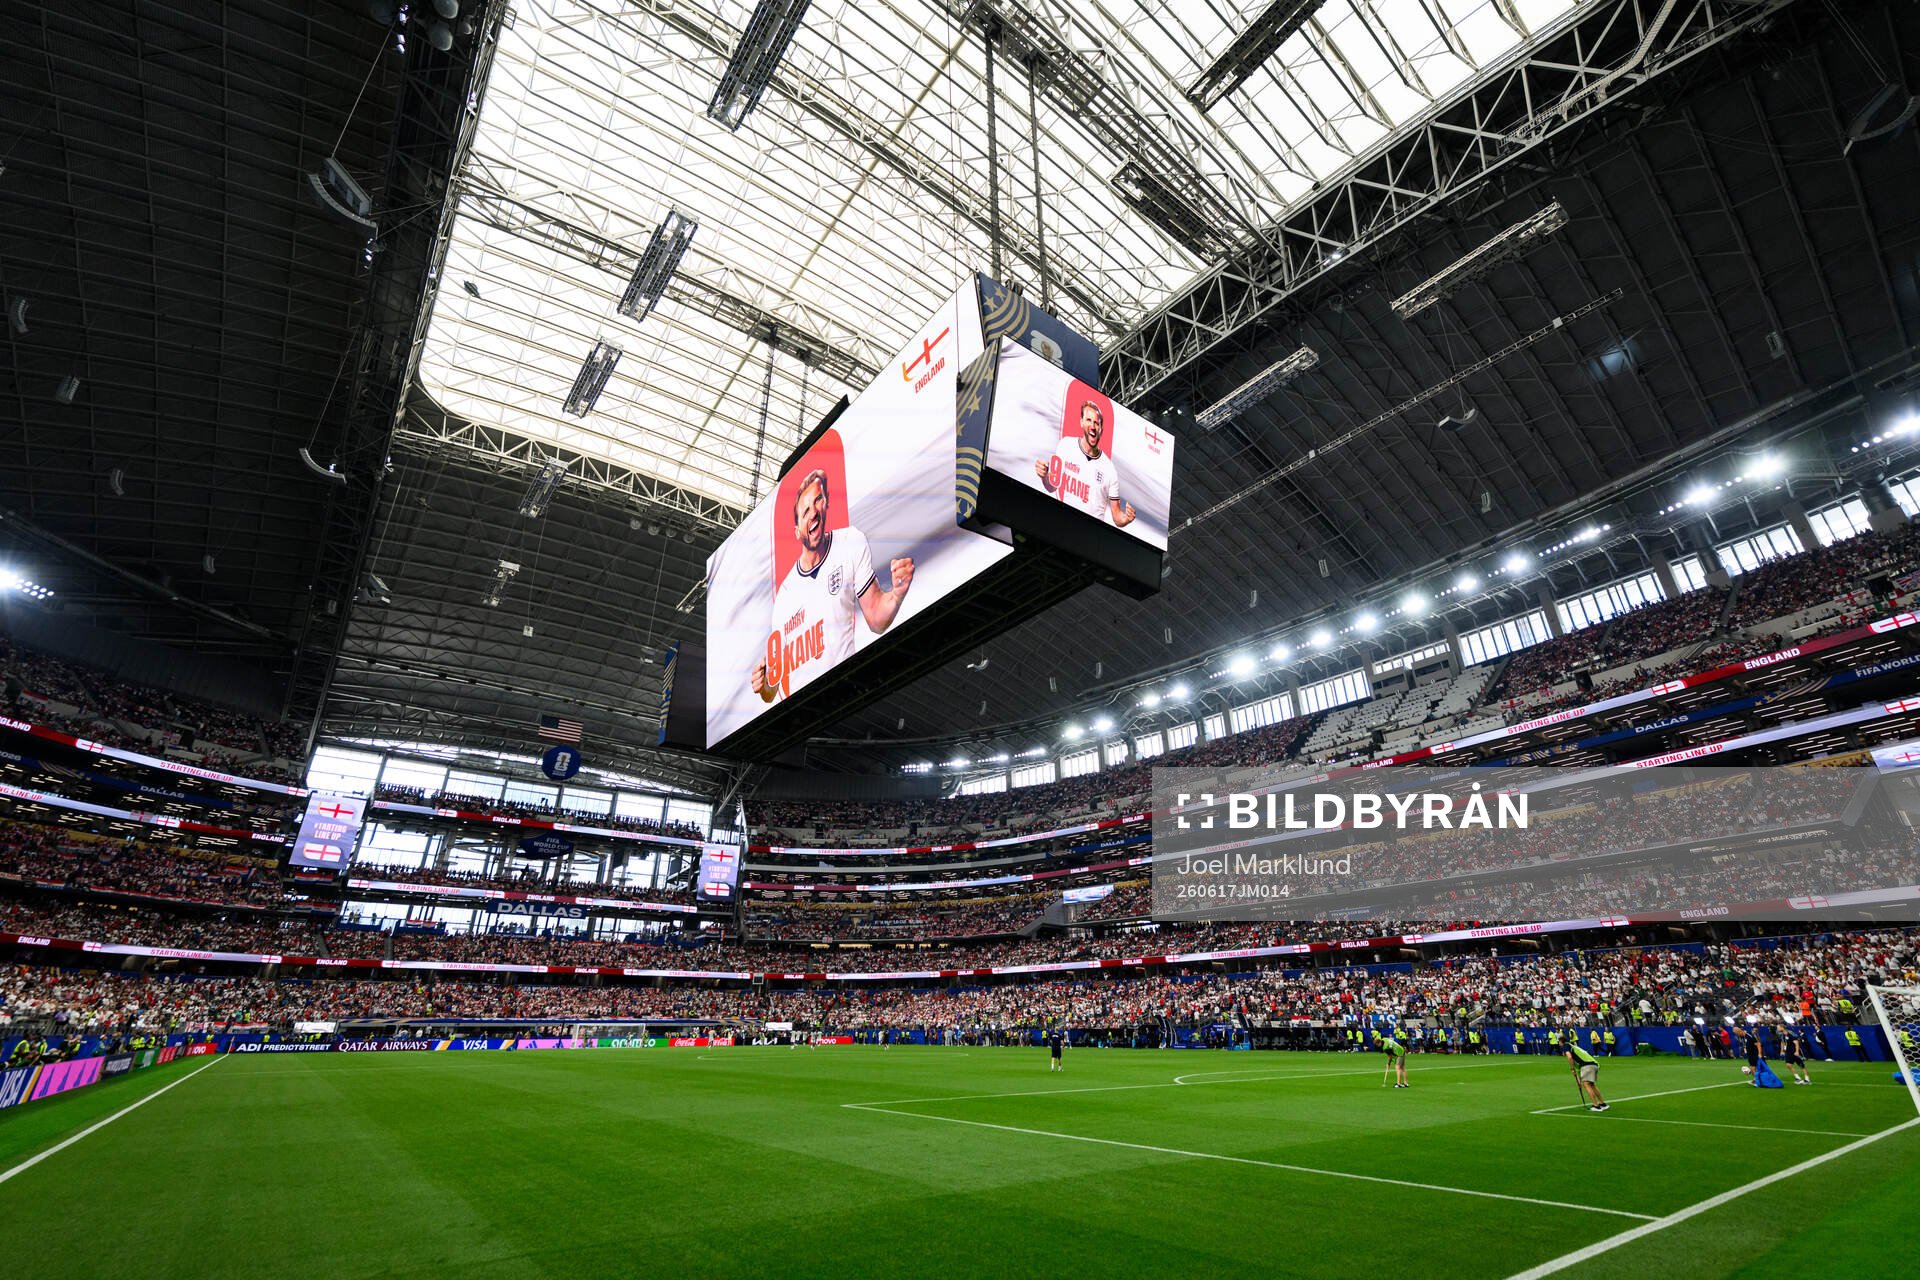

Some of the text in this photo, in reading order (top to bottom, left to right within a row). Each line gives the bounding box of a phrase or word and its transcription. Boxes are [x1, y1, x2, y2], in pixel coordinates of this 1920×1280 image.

[915, 357, 945, 394] ENGLAND
[1049, 454, 1063, 488] 9
[1064, 460, 1081, 474] HARRY
[1059, 472, 1090, 504] KANE
[784, 608, 806, 637] HARRY
[767, 629, 783, 687] 9
[781, 617, 825, 697] KANE
[1744, 647, 1801, 671] ENGLAND
[1855, 665, 1882, 678] FIFA
[1507, 707, 1586, 735] STARTING LINE UP
[1634, 714, 1689, 734] DALLAS
[1636, 743, 1723, 769] STARTING LINE UP
[1362, 757, 1394, 771] ENGLAND
[160, 761, 234, 784] STARTING LINE UP
[11, 788, 29, 798] LINE
[31, 793, 43, 802] UP
[140, 785, 185, 799] DALLAS
[492, 816, 521, 825] ENGLAND
[1122, 814, 1145, 824] ENGLAND
[251, 832, 285, 843] ENGLAND
[1100, 839, 1125, 848] DALLAS
[397, 884, 433, 893] STARTING
[527, 894, 555, 902] ENGLAND
[497, 901, 583, 919] DALLAS
[1680, 906, 1729, 919] ENGLAND
[1470, 924, 1542, 938] STARTING LINE UP
[17, 936, 51, 946] ENGLAND
[1340, 940, 1370, 949] ENGLAND
[150, 949, 186, 958] STARTING
[1210, 951, 1237, 959] STARTING
[316, 958, 348, 966] ENGLAND
[1122, 958, 1143, 966] ENGLAND
[338, 1040, 428, 1053] QATAR AIRWAYS
[462, 1039, 489, 1051] VISA
[611, 1038, 656, 1048] armo
[816, 1037, 837, 1045] novo
[236, 1043, 331, 1053] ADI PREDICTSTREET
